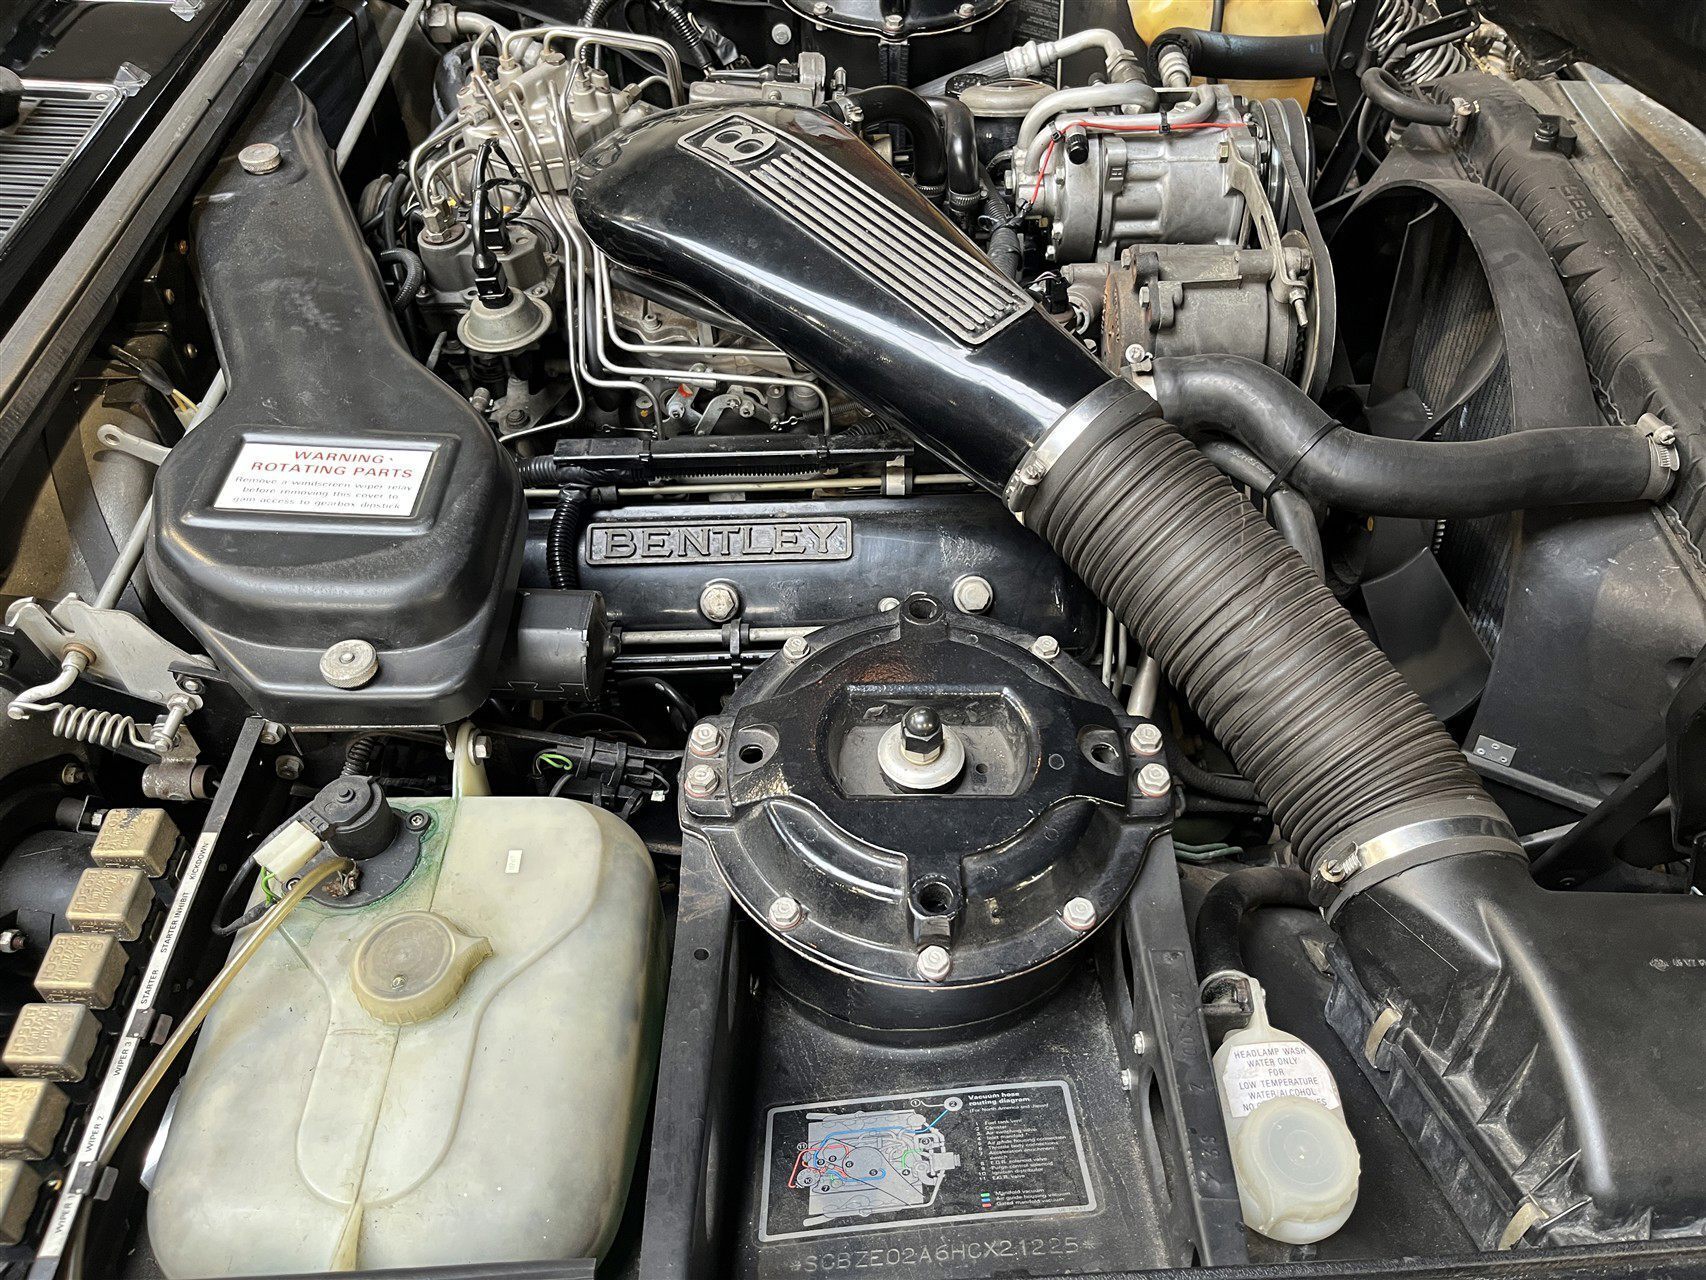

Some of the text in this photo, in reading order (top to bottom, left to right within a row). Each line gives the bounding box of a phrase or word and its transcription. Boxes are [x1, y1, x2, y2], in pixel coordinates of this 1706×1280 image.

[295, 451, 385, 464] WARNING
[251, 461, 413, 478] ROTATING PARTS
[235, 476, 277, 485] Remove
[292, 480, 350, 488] windscreen
[242, 486, 276, 494] before
[280, 489, 328, 498] removing
[360, 501, 400, 509] dipstick
[604, 522, 839, 559] BENTLEY
[189, 842, 209, 880] KICKDOWN
[160, 891, 190, 953] STARTER INHIBIT
[40, 937, 67, 980] BOSCH
[140, 969, 159, 1005] STARTER
[1234, 1046, 1307, 1059] HEADLAMP WASH
[113, 1052, 129, 1077] WIPER
[1247, 1056, 1298, 1068] WATER ONLY
[1268, 1068, 1285, 1076] FOR
[1238, 1076, 1318, 1090] LOW TEMPERATURE
[1243, 1102, 1255, 1111] NO
[86, 1123, 101, 1153] WIPER
[55, 1201, 73, 1234] WIPER
